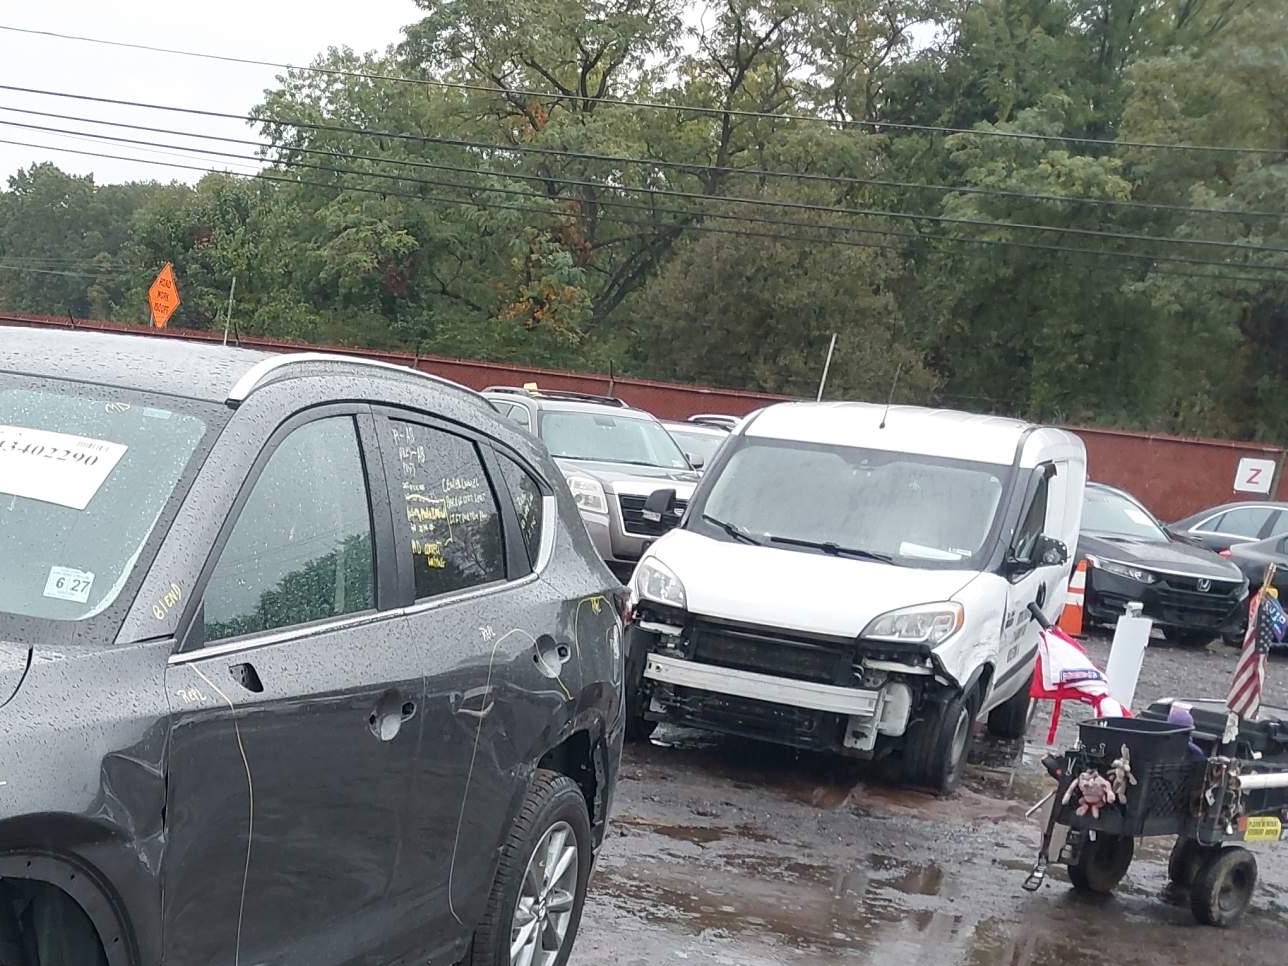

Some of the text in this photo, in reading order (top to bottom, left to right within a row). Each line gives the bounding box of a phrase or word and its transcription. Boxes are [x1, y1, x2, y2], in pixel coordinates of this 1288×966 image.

[1245, 468, 1262, 485] Z
[56, 576, 91, 593] 6 27
